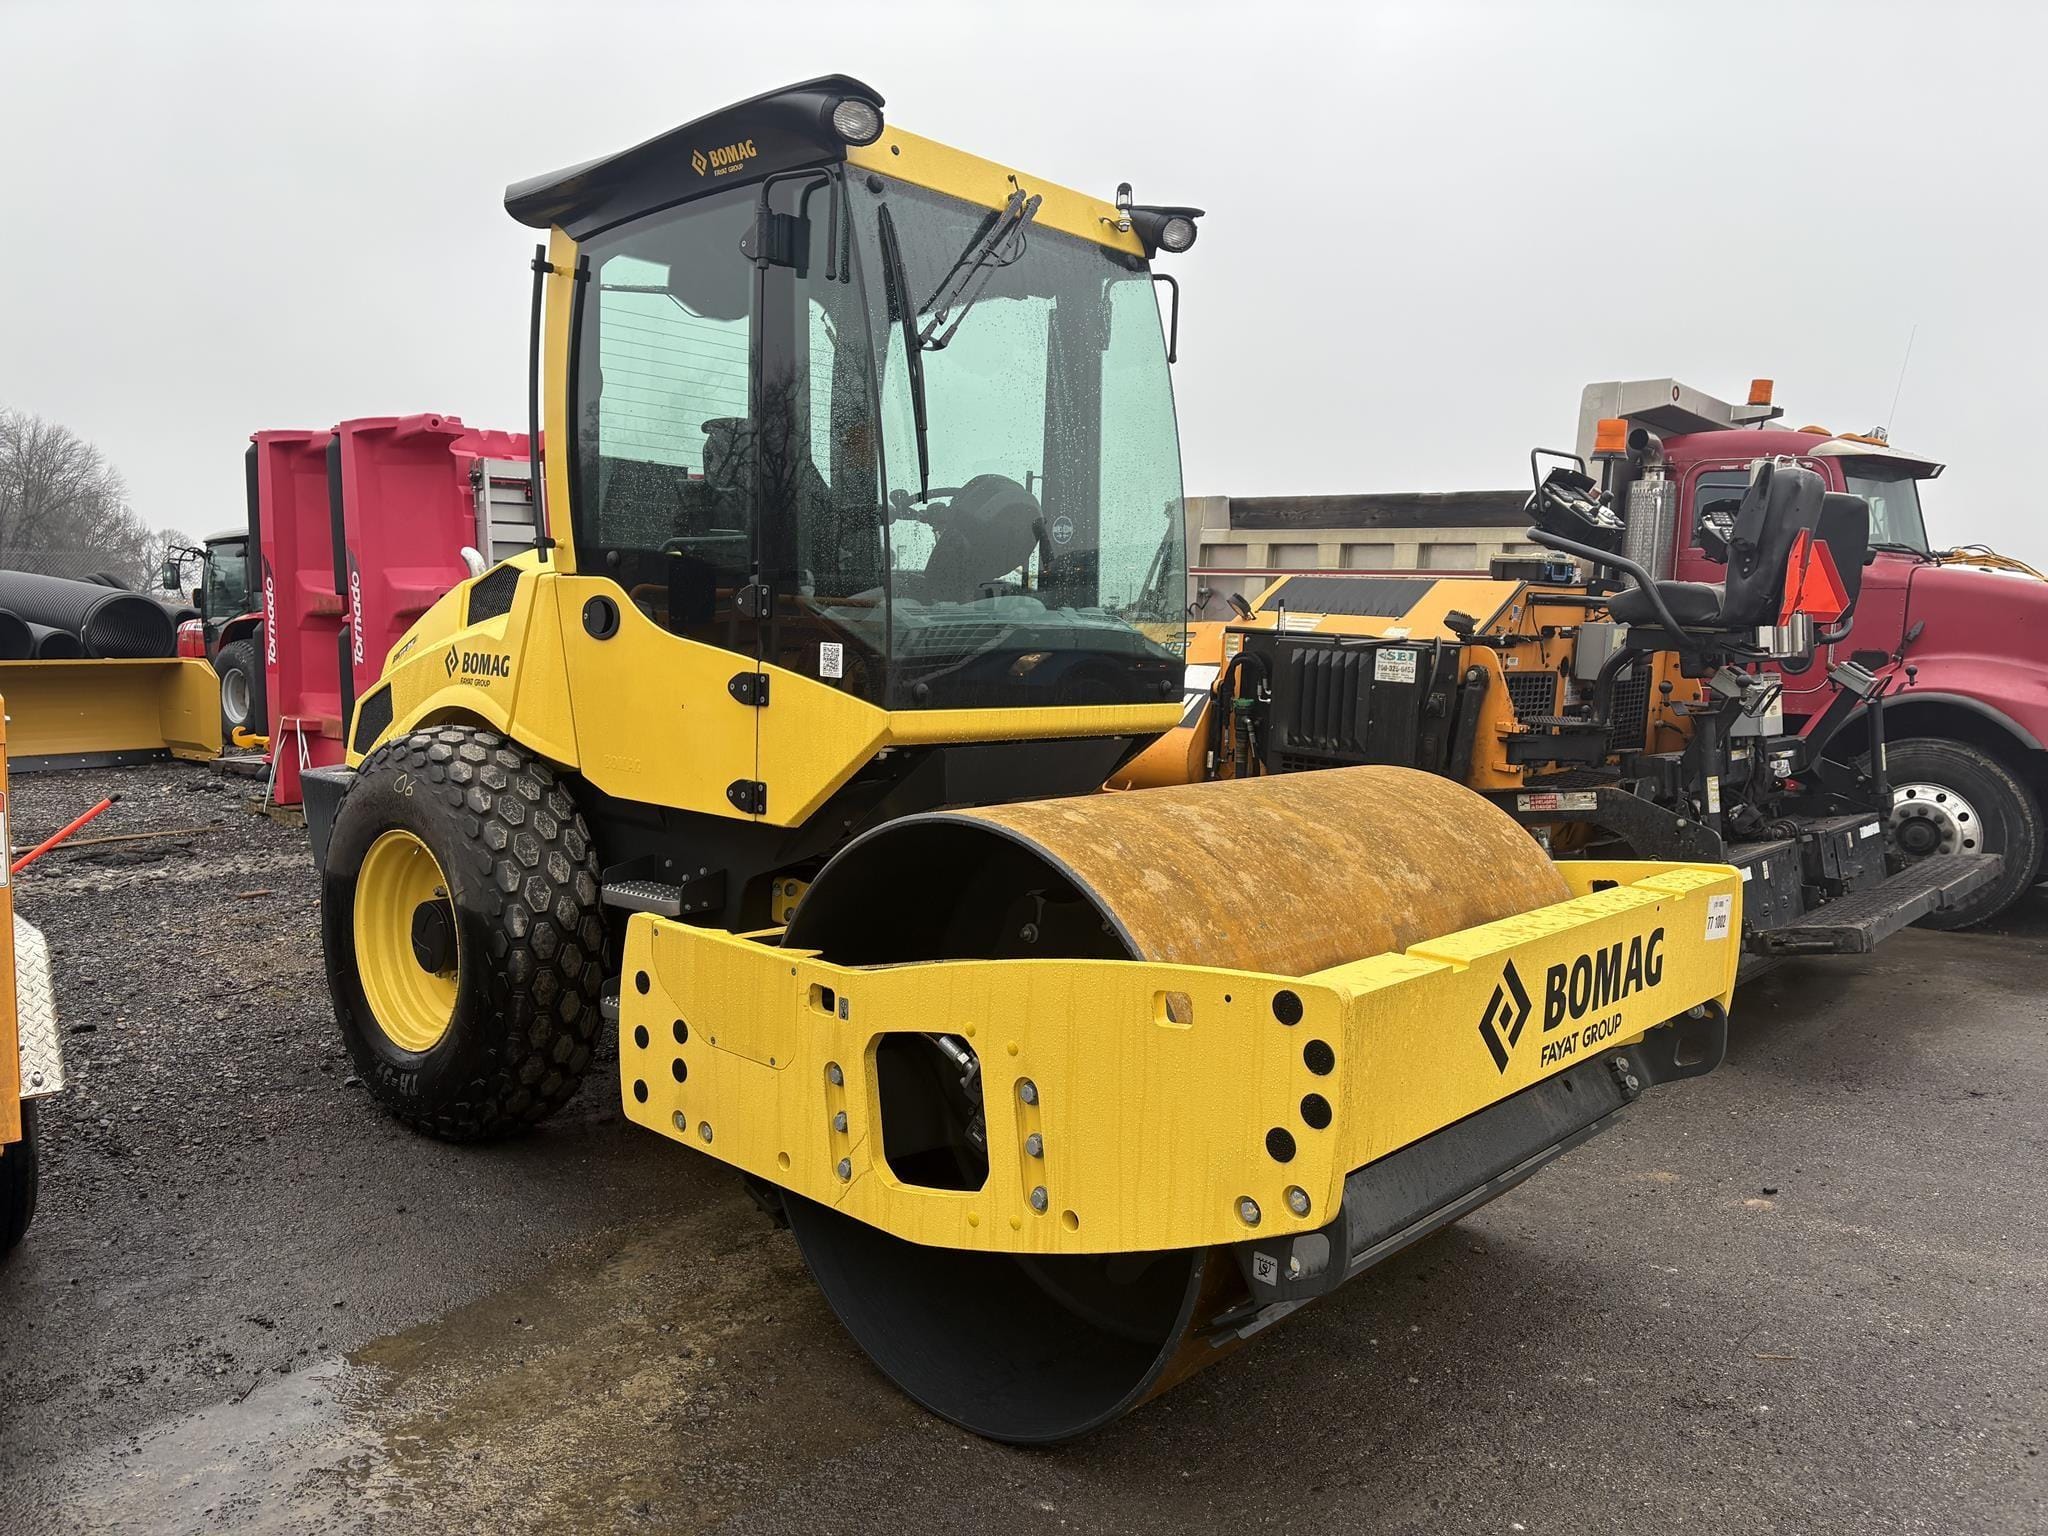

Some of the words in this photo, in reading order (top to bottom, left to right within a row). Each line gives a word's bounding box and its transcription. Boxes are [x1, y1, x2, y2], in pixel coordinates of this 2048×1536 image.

[708, 139, 757, 168] BOMAG
[728, 163, 744, 173] GROUP
[265, 577, 277, 666] Tornado
[351, 571, 364, 666] Tornado
[462, 652, 510, 678] BOMAG
[474, 678, 491, 688] GROUP
[1543, 927, 1665, 1032] BOMAG
[1540, 1031, 1579, 1068] FAYAT
[1582, 1013, 1622, 1048] GROUP
